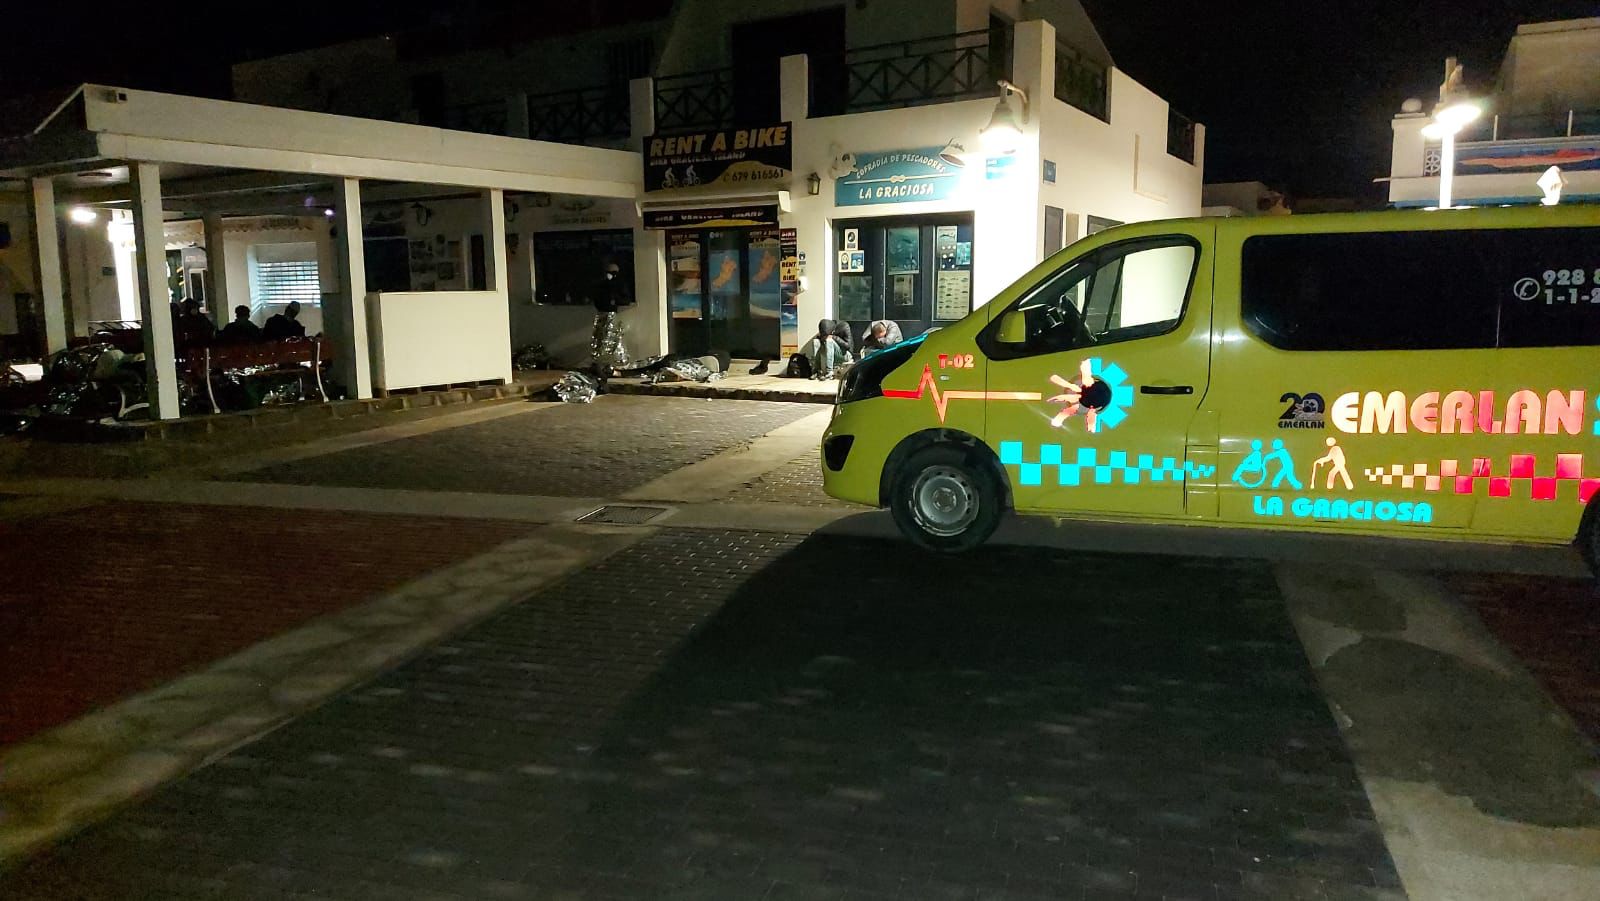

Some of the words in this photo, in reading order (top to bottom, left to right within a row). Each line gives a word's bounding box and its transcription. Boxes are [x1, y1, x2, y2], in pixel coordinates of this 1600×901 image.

[650, 134, 706, 157] RENT
[711, 132, 727, 152] A
[734, 126, 787, 149] BIKE
[902, 153, 946, 173] PESCADORES
[732, 171, 749, 182] 679
[751, 169, 784, 181] 616561
[859, 187, 872, 199] LA
[876, 183, 934, 198] GRACIOSA
[1542, 269, 1585, 286] 928
[938, 354, 974, 369] T-02
[1331, 389, 1585, 435] EMERLAN
[1278, 421, 1325, 429] EMERLAN
[1253, 495, 1283, 516] LA
[1291, 497, 1433, 523] GRACIOSA
